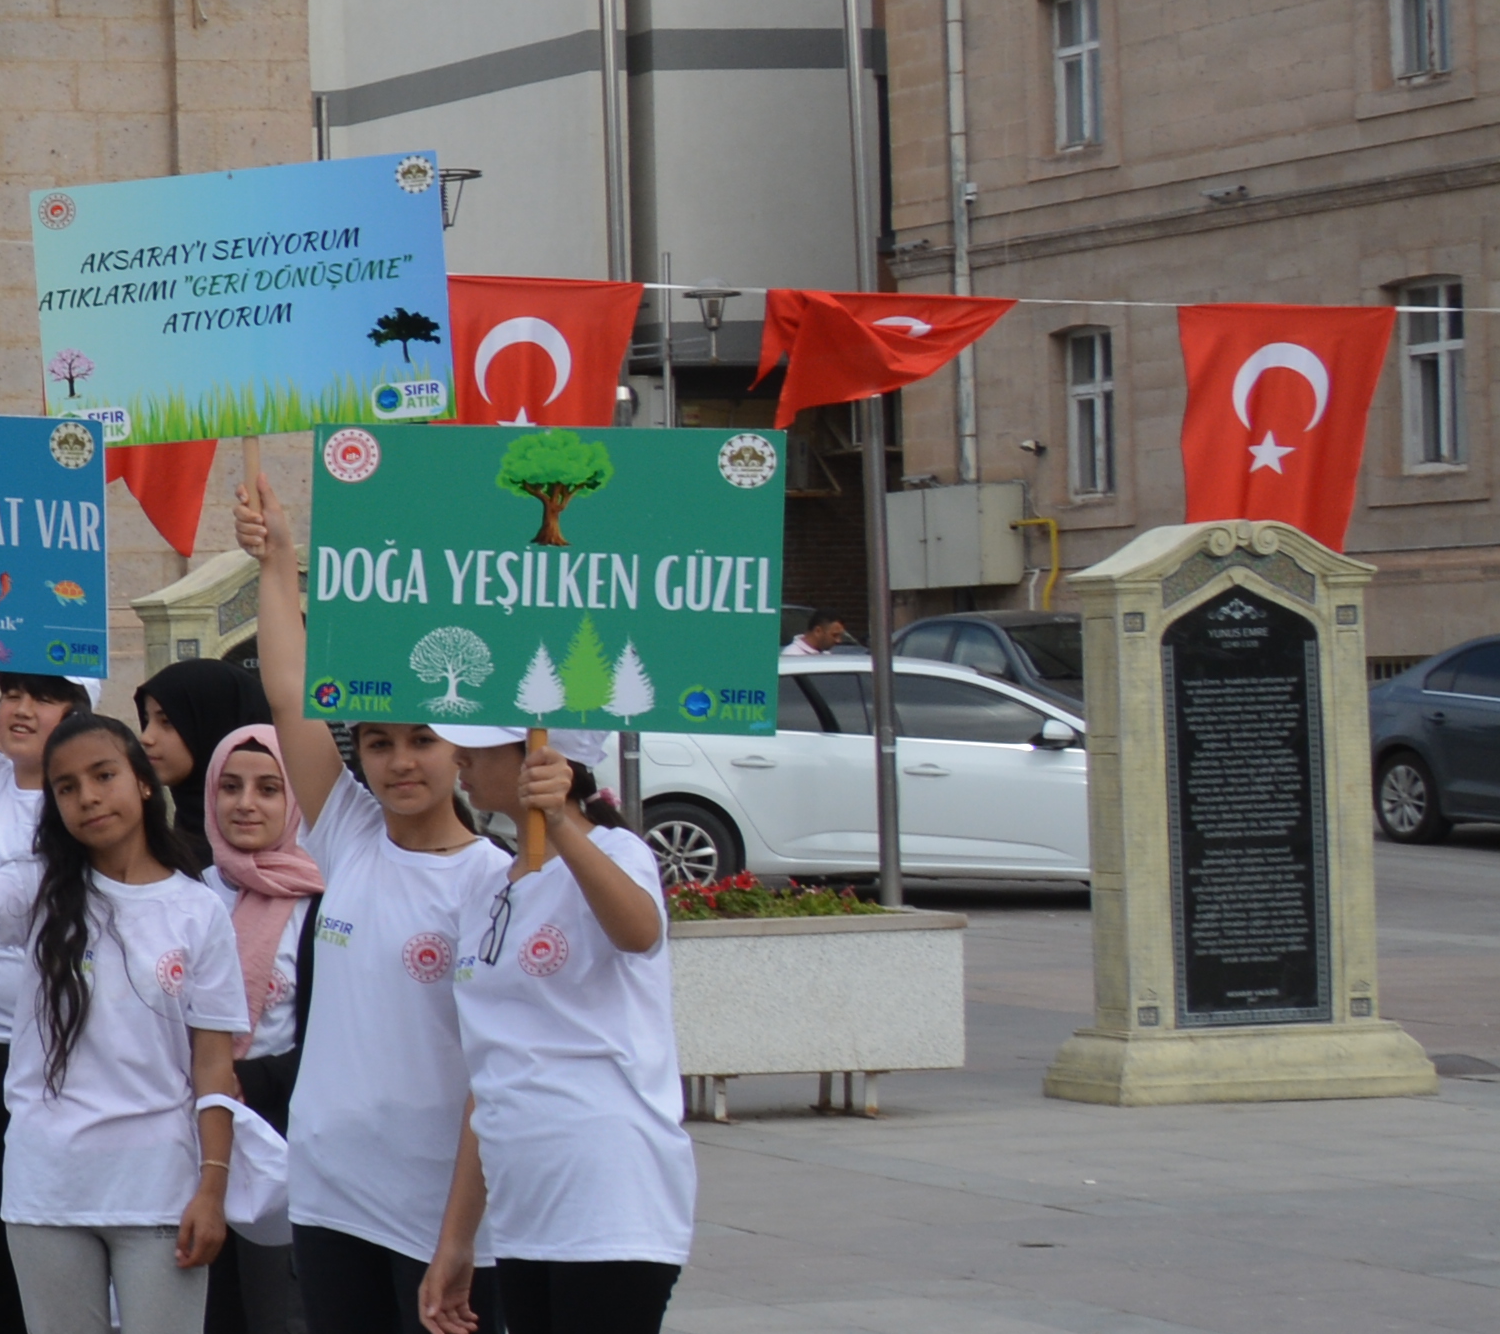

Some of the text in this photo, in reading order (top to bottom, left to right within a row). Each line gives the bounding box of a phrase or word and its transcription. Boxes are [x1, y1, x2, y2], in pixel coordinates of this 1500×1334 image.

[80, 226, 361, 275] AKSARAY'I SEVİYORUM
[37, 278, 177, 312] ATIKLARIMI
[162, 301, 293, 334] ATIYORUM
[404, 382, 440, 397] SIFIR
[405, 395, 440, 410] ATIK
[35, 498, 100, 552] VAR
[316, 540, 776, 615] DOĞA YEŞİLKEN GÜZEL
[70, 642, 99, 655] SIFIR
[348, 680, 393, 697] SIFIR
[719, 688, 766, 705] SIFIR
[348, 695, 393, 713] ATIK
[719, 704, 765, 722] ATIK
[321, 916, 354, 936] SIFIR
